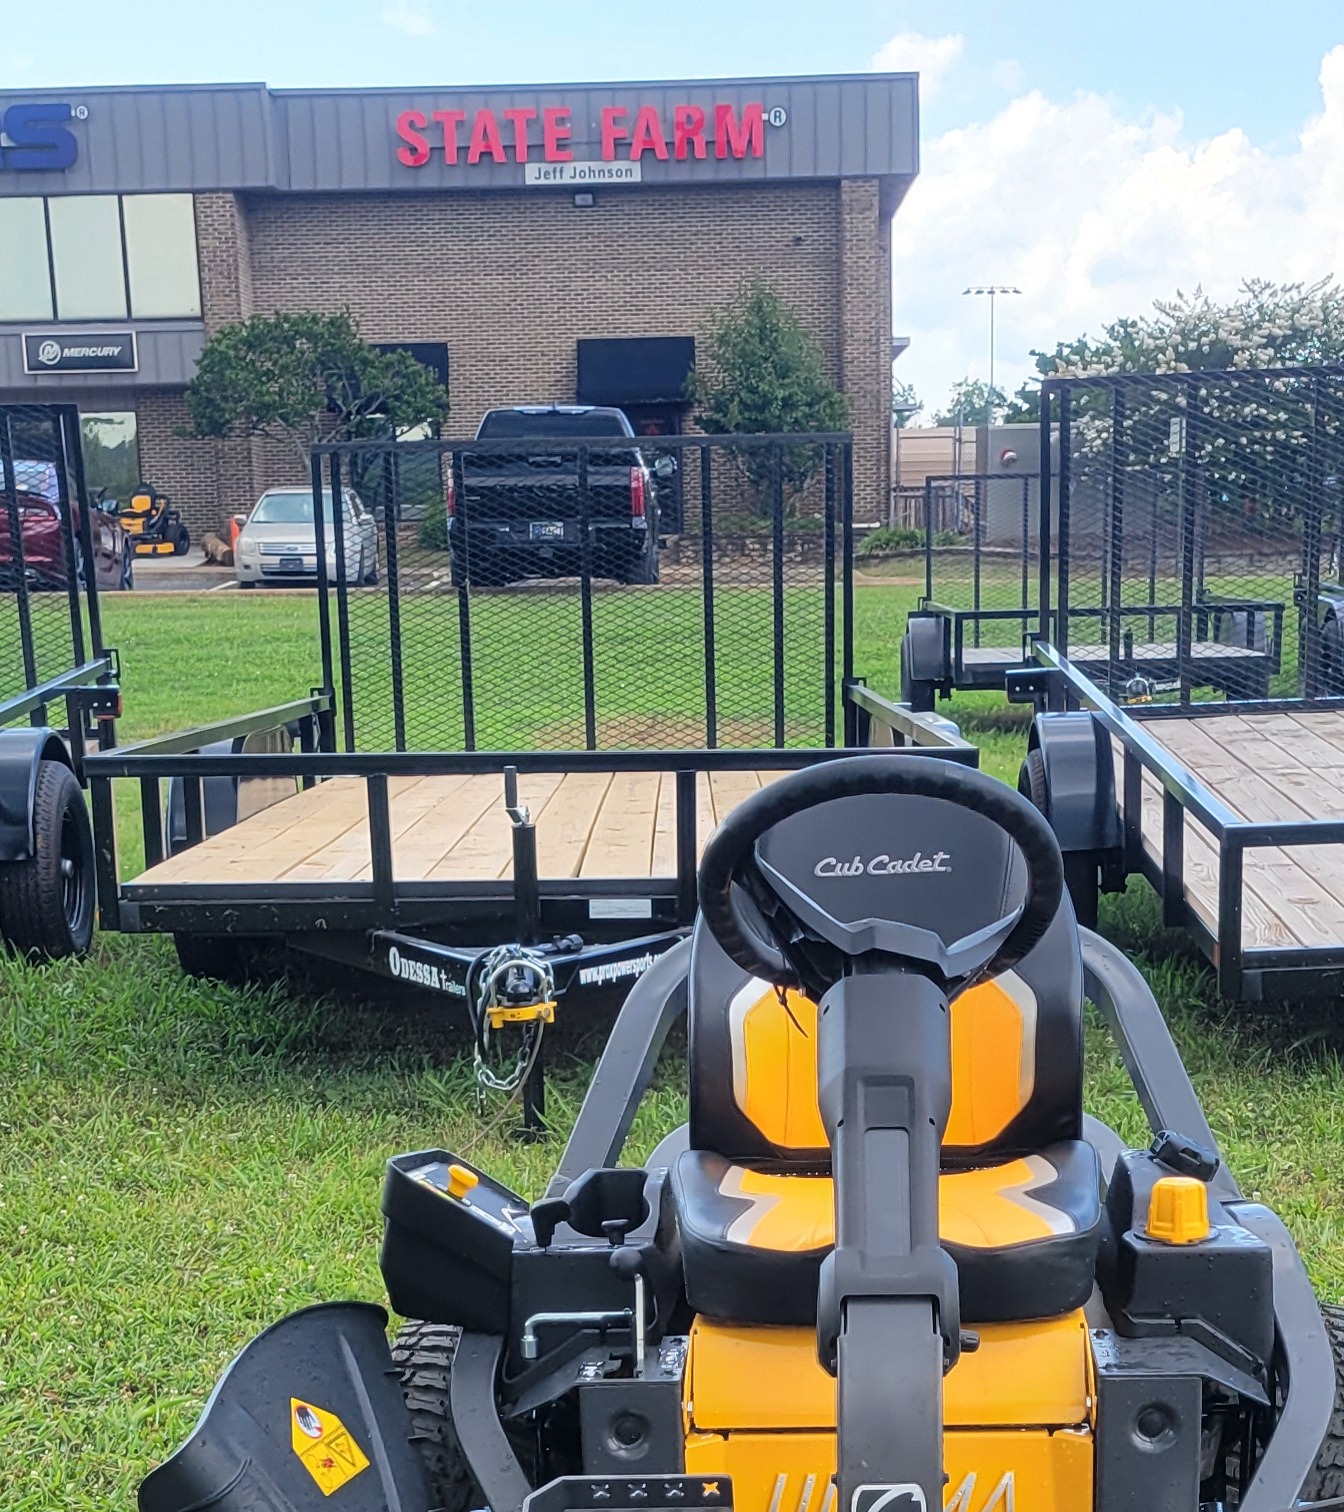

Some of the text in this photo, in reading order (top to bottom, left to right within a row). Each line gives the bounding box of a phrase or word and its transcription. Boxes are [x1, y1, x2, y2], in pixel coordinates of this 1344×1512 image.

[396, 104, 764, 167] STATE FARM
[533, 163, 633, 181] Jeff Johnson
[62, 346, 122, 358] MERCURY
[814, 851, 951, 877] Cub Cadet
